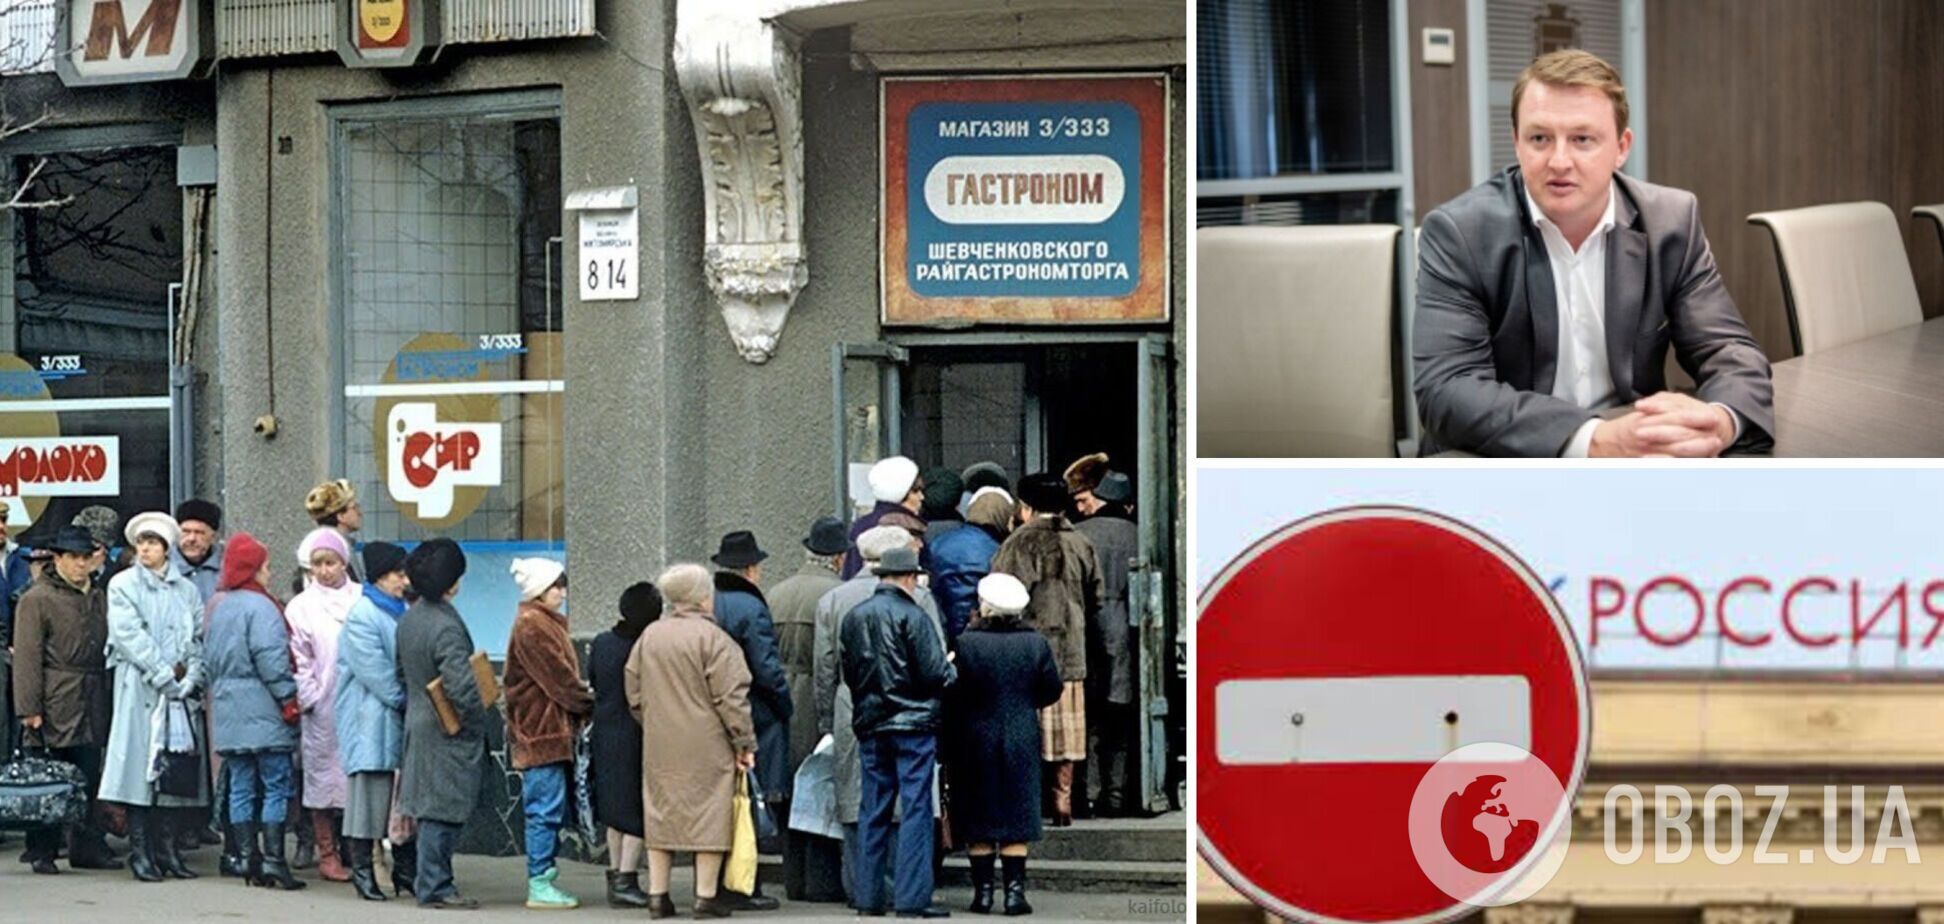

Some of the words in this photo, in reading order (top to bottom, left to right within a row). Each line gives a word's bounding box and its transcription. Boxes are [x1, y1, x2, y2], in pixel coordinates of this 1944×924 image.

[939, 120, 1029, 138] МАГАЗИН
[1039, 116, 1110, 138] 3/333
[946, 172, 1104, 205] ГАСТРОНОМ
[928, 241, 1108, 260] ШЕВЧЕНКОВСКОГО
[588, 260, 598, 290] 8
[916, 261, 1129, 281] РАЙГАСТРОНОМТОРГА
[478, 333, 523, 349] 3/333
[40, 355, 81, 370] 3/333
